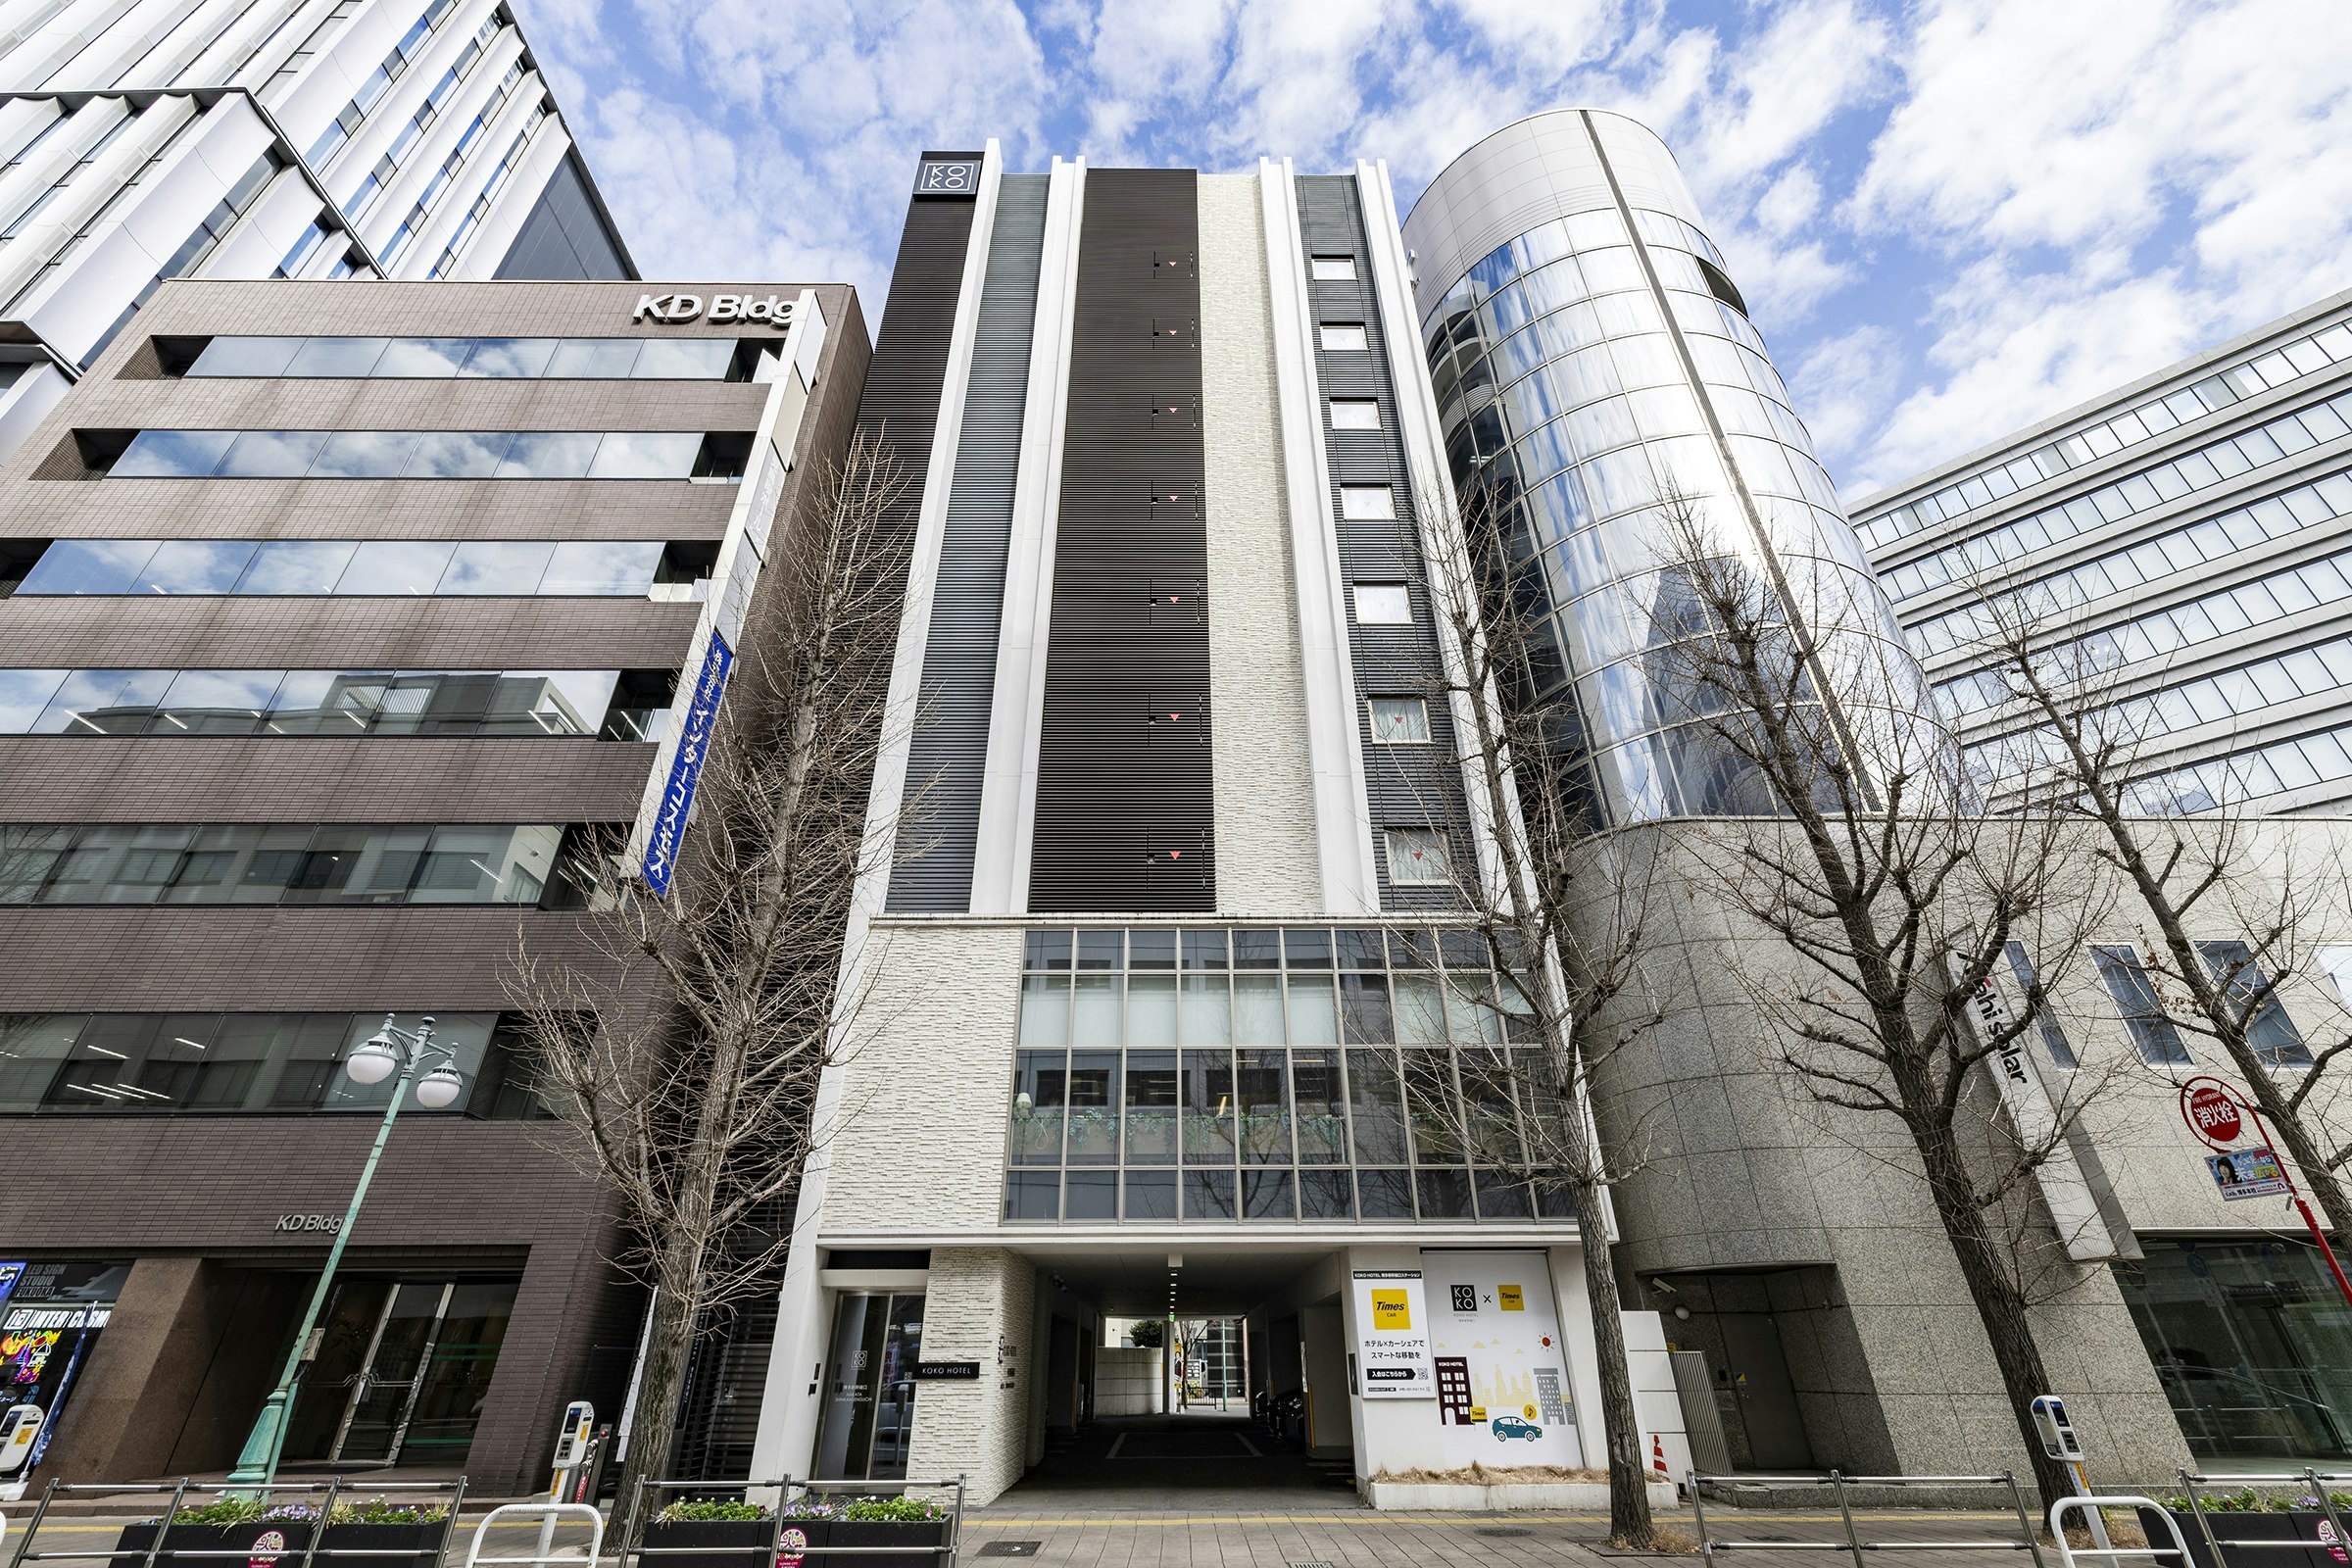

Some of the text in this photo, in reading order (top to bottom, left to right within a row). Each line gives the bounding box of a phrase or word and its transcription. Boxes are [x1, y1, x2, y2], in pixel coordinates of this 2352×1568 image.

[632, 294, 794, 327] KD Bldg
[2191, 1096, 2203, 1104] FIRE
[2193, 1102, 2238, 1129] 消火栓
[275, 1214, 343, 1234] KD Bldg
[25, 1264, 44, 1275] LED
[42, 1264, 67, 1275] SIGN
[20, 1275, 55, 1286] STUDIO
[15, 1287, 54, 1298] FUKUOKA
[1376, 1301, 1405, 1311] Times
